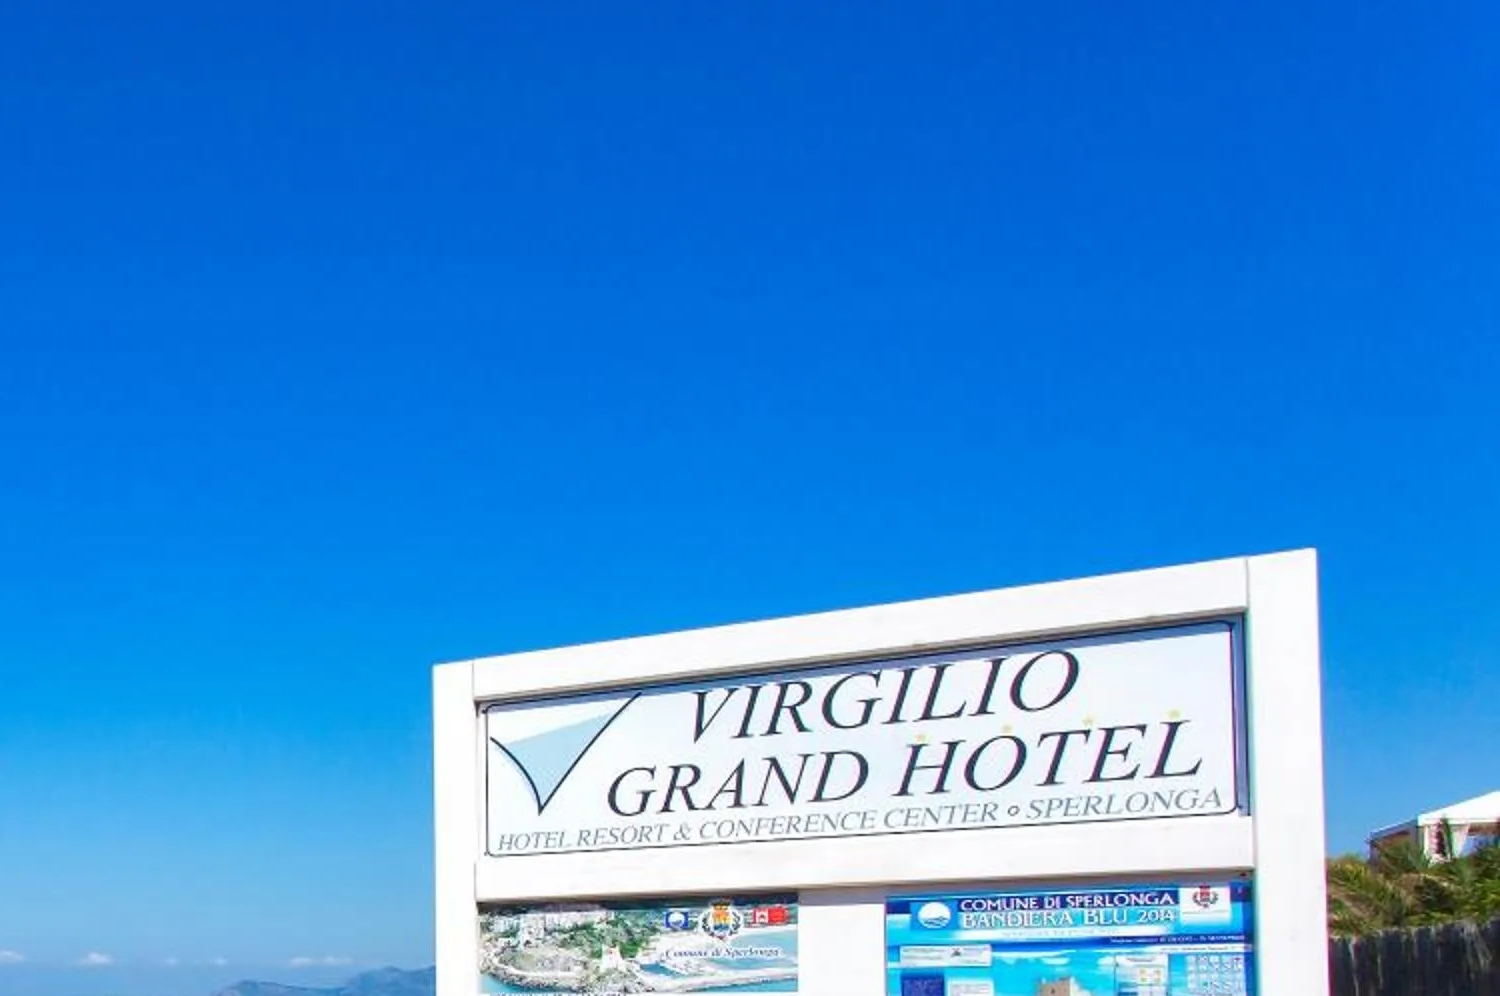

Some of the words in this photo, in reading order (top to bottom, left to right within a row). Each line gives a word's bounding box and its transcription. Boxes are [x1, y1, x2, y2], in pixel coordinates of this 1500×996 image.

[692, 649, 1080, 744] VIRGILIO
[607, 749, 870, 817] GRAND
[892, 718, 1204, 797] HOTEL
[497, 832, 570, 851] HOTEL
[576, 823, 670, 847] RESORT
[673, 822, 692, 841] &
[698, 808, 877, 840] CONFERENCE
[883, 801, 1001, 830] CENTER
[1025, 786, 1223, 819] SPERLONGA
[960, 896, 1038, 911] COMUNE
[1044, 895, 1061, 909] DI
[1066, 892, 1175, 908] SPERLONGA
[962, 909, 1074, 929] BANDIERA
[1083, 905, 1129, 926] BLU
